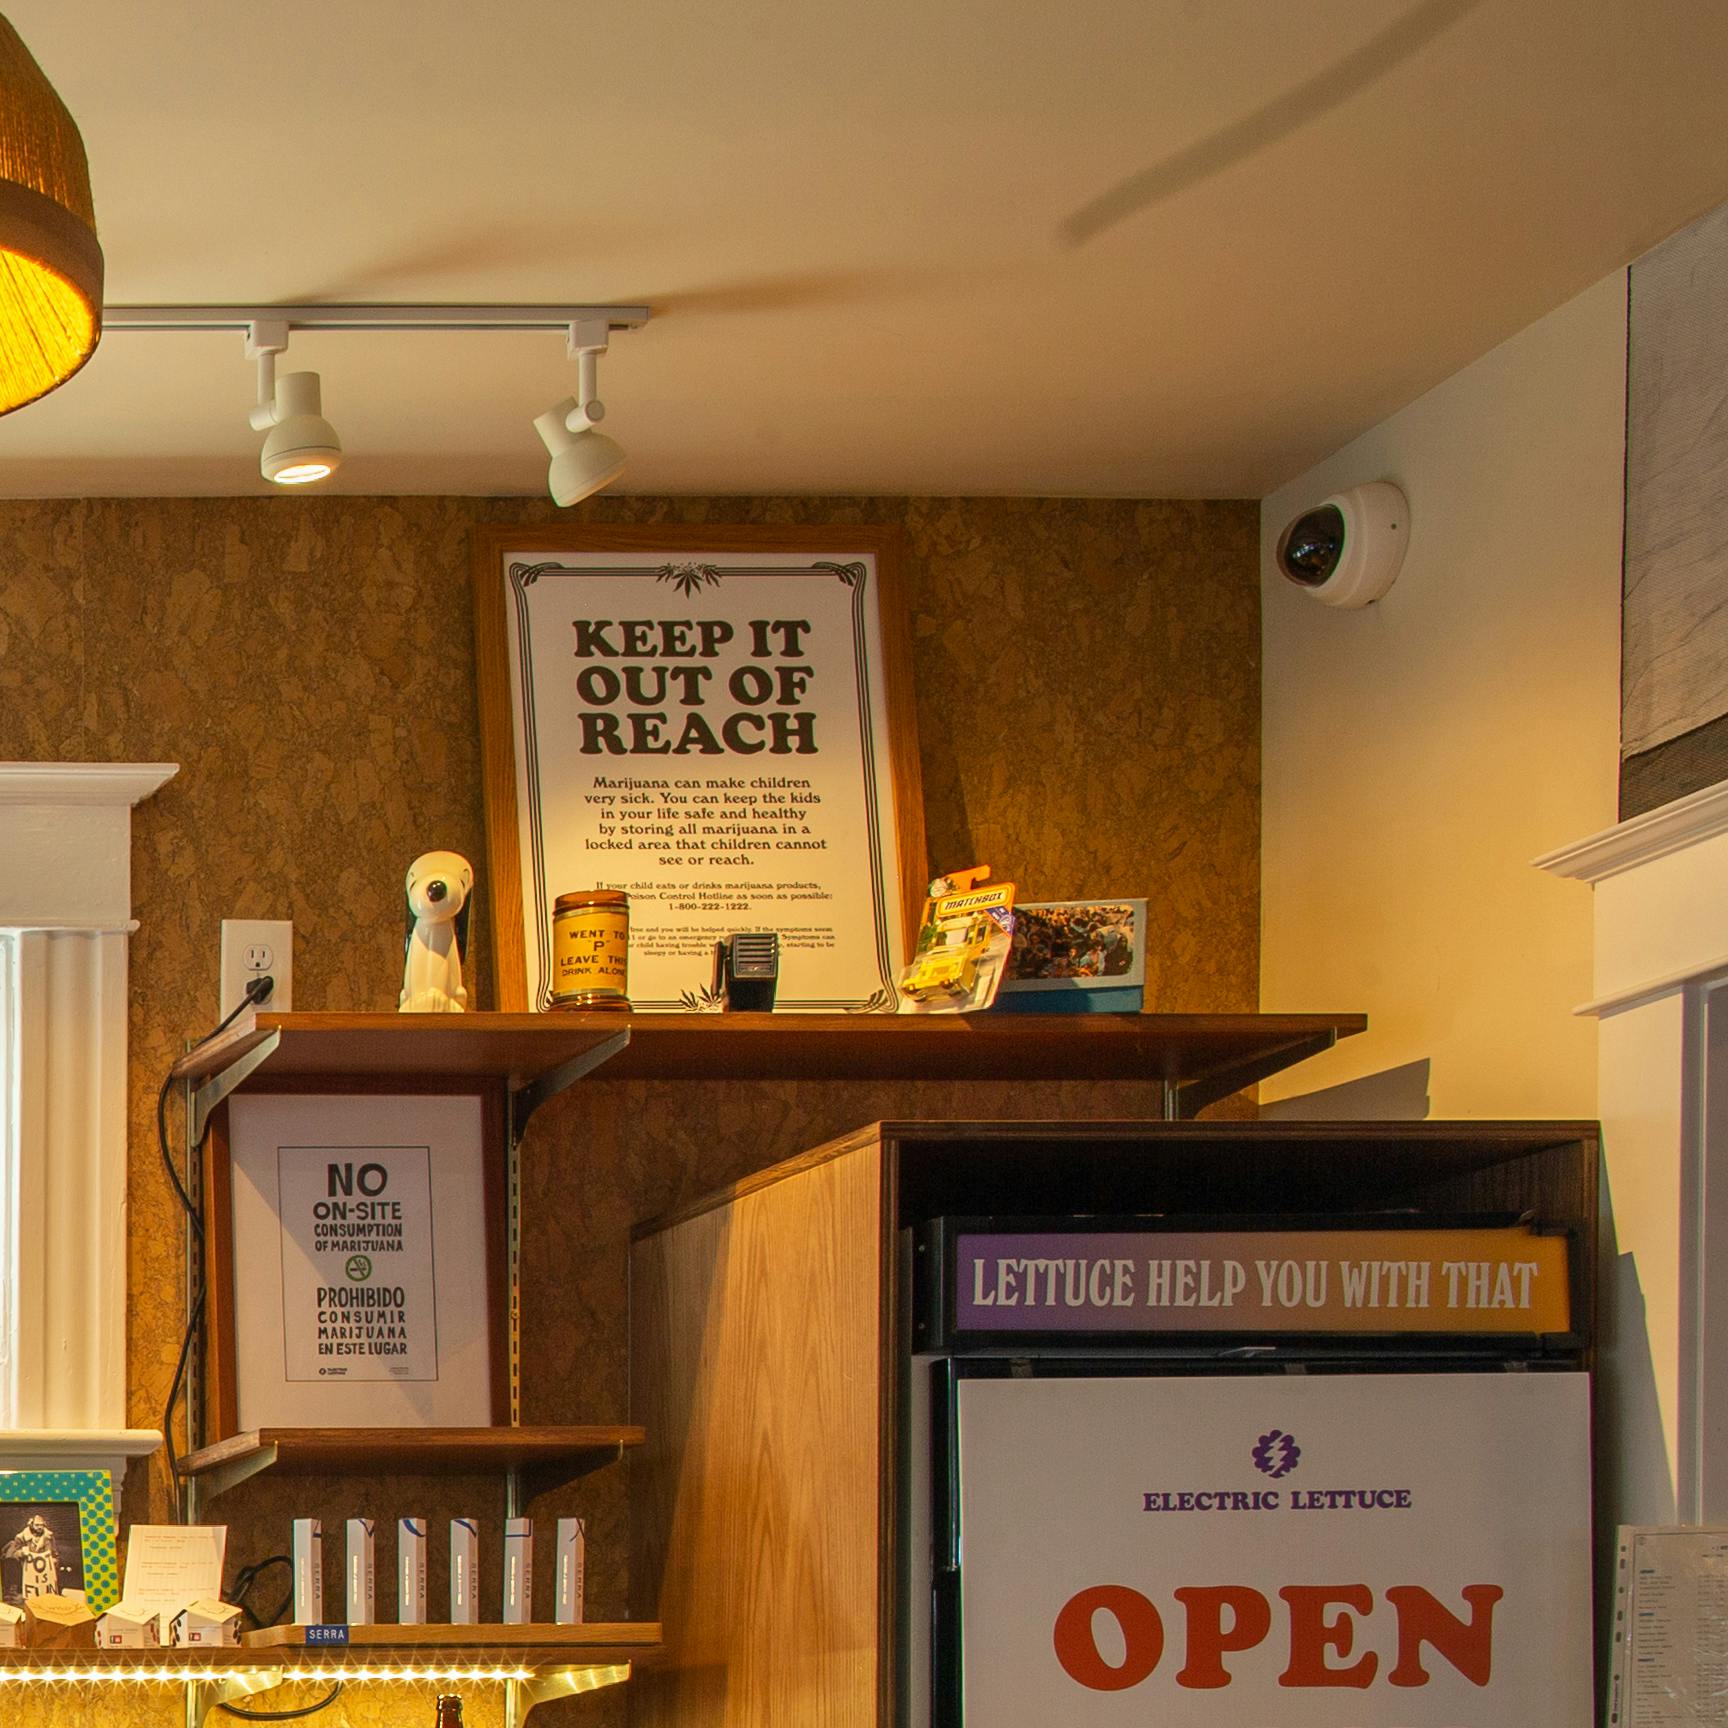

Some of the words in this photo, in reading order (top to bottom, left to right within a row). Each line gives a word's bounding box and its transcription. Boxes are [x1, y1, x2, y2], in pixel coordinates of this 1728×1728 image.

[573, 619, 735, 659] KEEP
[750, 619, 812, 659] IT
[576, 666, 712, 706] OUT
[728, 665, 816, 707] OF
[579, 711, 819, 756] REACH
[593, 777, 669, 790] Marijuana
[674, 780, 701, 788] can
[706, 778, 745, 788] make
[750, 777, 811, 788] children
[584, 794, 615, 806] very
[621, 793, 655, 804] sick.
[659, 793, 687, 804] You
[693, 795, 719, 804] can
[723, 793, 757, 806] keep
[762, 793, 785, 804] the
[790, 793, 821, 804] kids
[601, 808, 615, 819] in
[619, 810, 652, 821] your
[657, 808, 680, 819] life
[684, 808, 715, 819] safe
[720, 808, 746, 819] and
[752, 808, 806, 821] healthy
[599, 823, 615, 836] by
[621, 823, 674, 836] storing
[678, 824, 696, 835] all
[702, 824, 777, 836] marijuana
[782, 824, 796, 835] in
[801, 826, 811, 835] a
[585, 839, 633, 850] locked
[638, 841, 671, 850] area
[676, 839, 707, 850] that
[711, 839, 771, 850] children
[775, 839, 828, 850] cannot
[659, 855, 683, 865] see
[688, 855, 704, 865] or
[709, 854, 755, 865] reach.
[596, 882, 604, 890] If
[606, 883, 627, 891] your
[630, 882, 653, 890] child
[692, 882, 722, 890] drinks
[725, 882, 774, 891] marijuana
[776, 883, 821, 891] products,
[659, 892, 696, 900] Control
[698, 892, 734, 900] Hotline
[790, 892, 833, 901] possible:
[944, 892, 1004, 910] MATCHBOX
[668, 903, 752, 911] 1-800-222-1222.
[569, 930, 605, 939] WENT
[613, 931, 625, 940] TO
[561, 955, 599, 966] LEAVE
[562, 968, 592, 976] DRINK
[327, 1162, 388, 1198] NO
[312, 1201, 402, 1221] ON-SITE
[314, 1223, 403, 1237] CONSUMPTION
[315, 1240, 328, 1251] OF
[332, 1240, 404, 1252] MARIJUANA
[972, 1257, 1135, 1309] LETTUCE
[1146, 1258, 1246, 1308] HELP
[1255, 1259, 1328, 1309] YOU
[1339, 1259, 1431, 1310] WITH
[1441, 1260, 1538, 1310] THAT
[317, 1286, 405, 1308] PROHIBIDO
[318, 1311, 406, 1324] CONSUMIR
[318, 1326, 407, 1340] MARIJUANA
[318, 1343, 334, 1355] EN
[336, 1343, 366, 1355] ESTE
[369, 1342, 407, 1355] LUGAR
[1143, 1490, 1280, 1513] ELECTRIC
[1290, 1488, 1412, 1511] LETTUCE
[36, 1573, 48, 1583] IS
[309, 1630, 344, 1639] SERRA
[1053, 1583, 1505, 1692] OPEN
